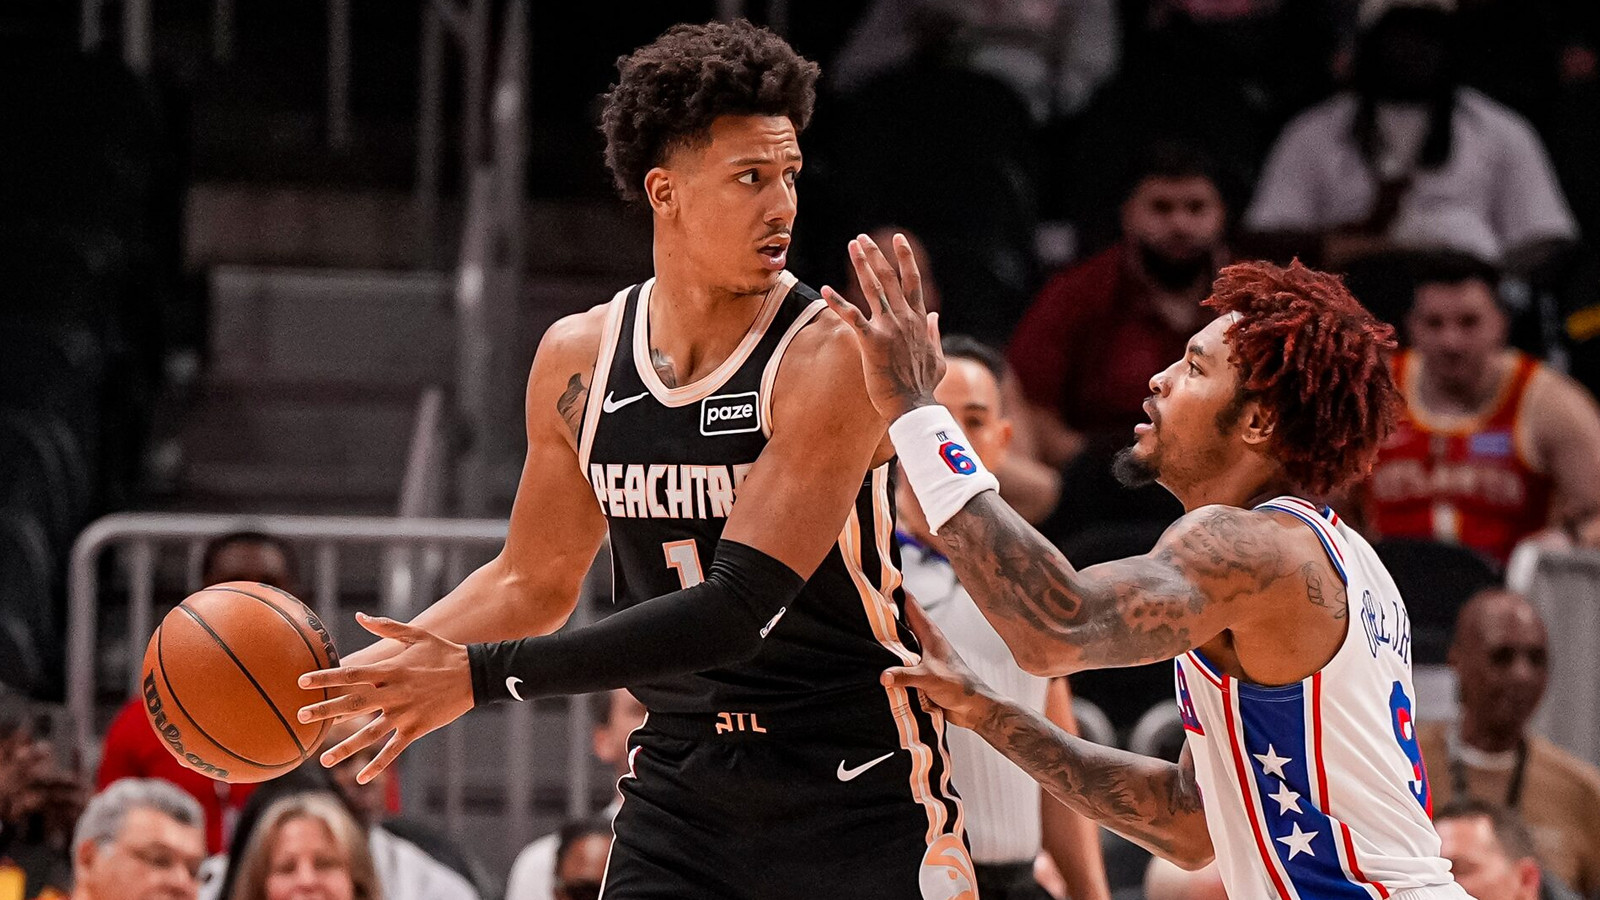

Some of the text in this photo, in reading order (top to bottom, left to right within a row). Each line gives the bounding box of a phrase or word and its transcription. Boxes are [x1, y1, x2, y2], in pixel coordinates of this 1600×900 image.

[706, 403, 754, 426] paze
[938, 441, 977, 476] 6
[662, 538, 705, 590] 1
[143, 668, 230, 779] Wilson
[715, 711, 767, 735] ATL
